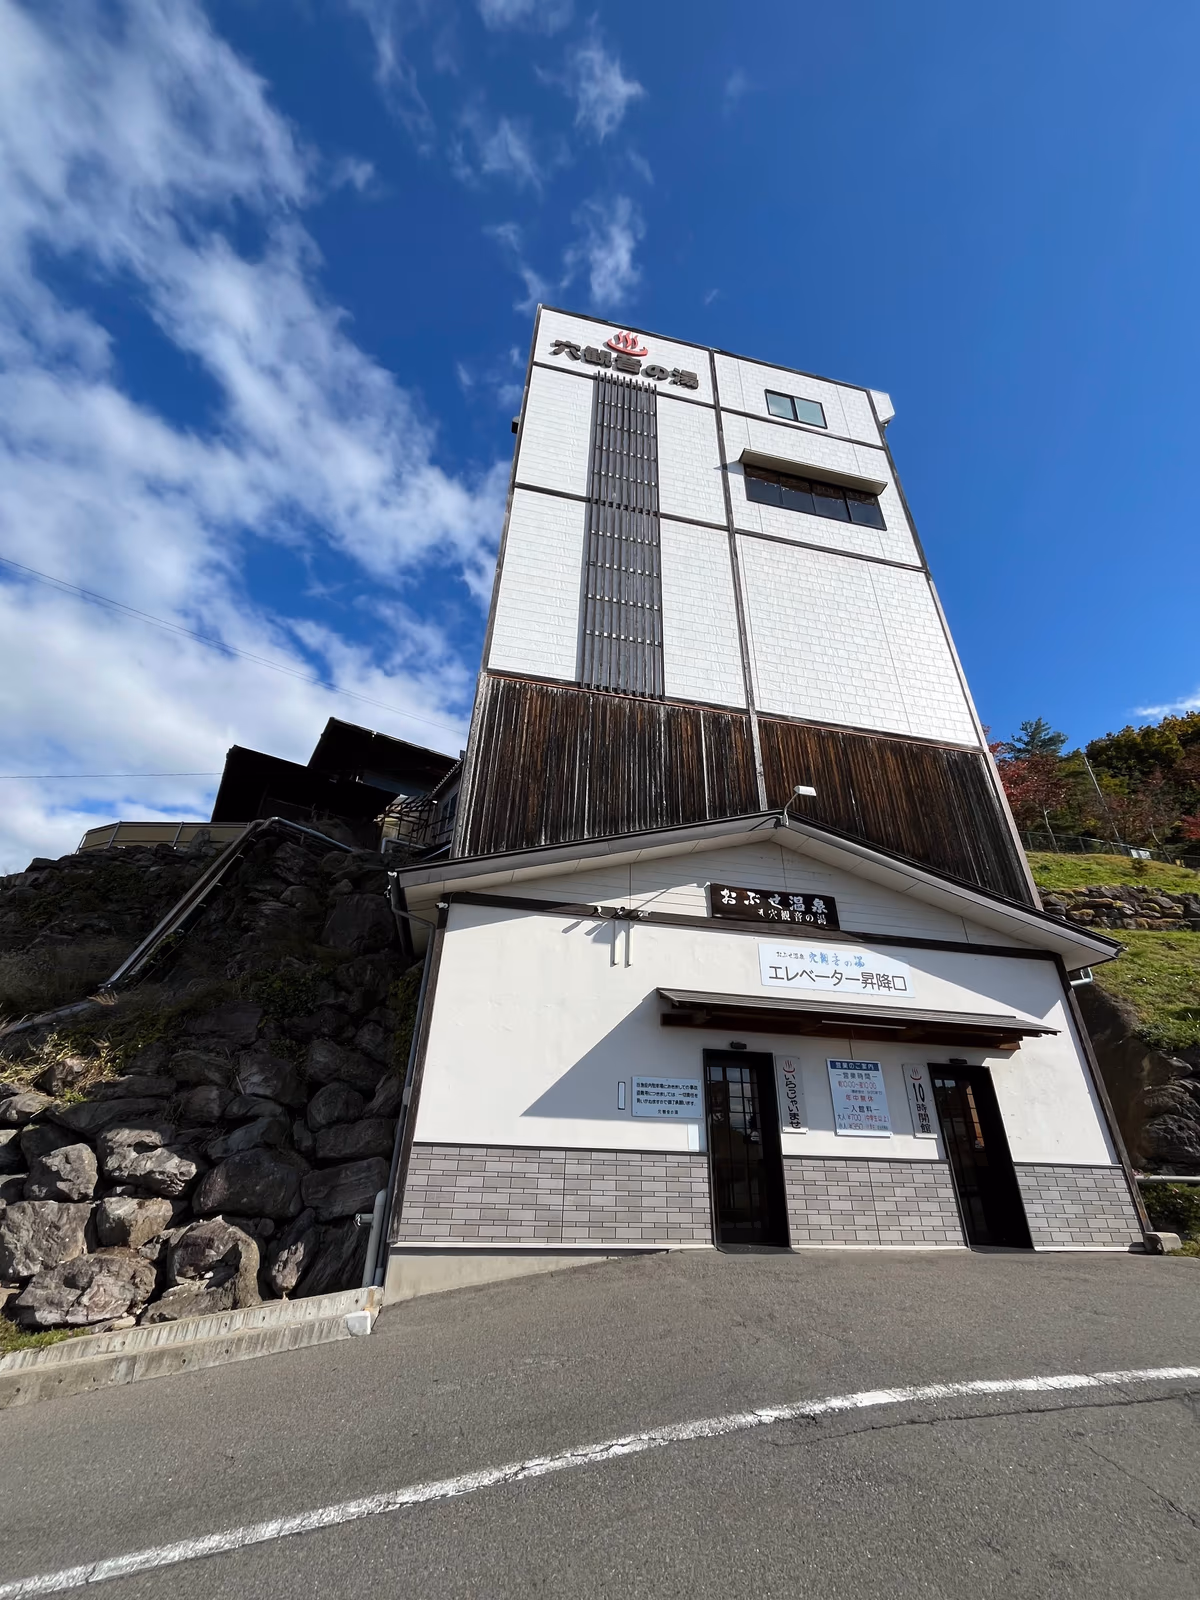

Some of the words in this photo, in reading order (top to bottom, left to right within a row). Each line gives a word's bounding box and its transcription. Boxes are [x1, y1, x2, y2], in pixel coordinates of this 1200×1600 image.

[549, 339, 699, 390] 穴観音の湯
[720, 888, 828, 913] おぶせ温泉
[769, 965, 907, 991] エレベーター昇降口
[808, 951, 866, 968] 穴観音の湯
[784, 1074, 802, 1129] いらっしゃいませ
[912, 1083, 932, 1133] 10時開館
